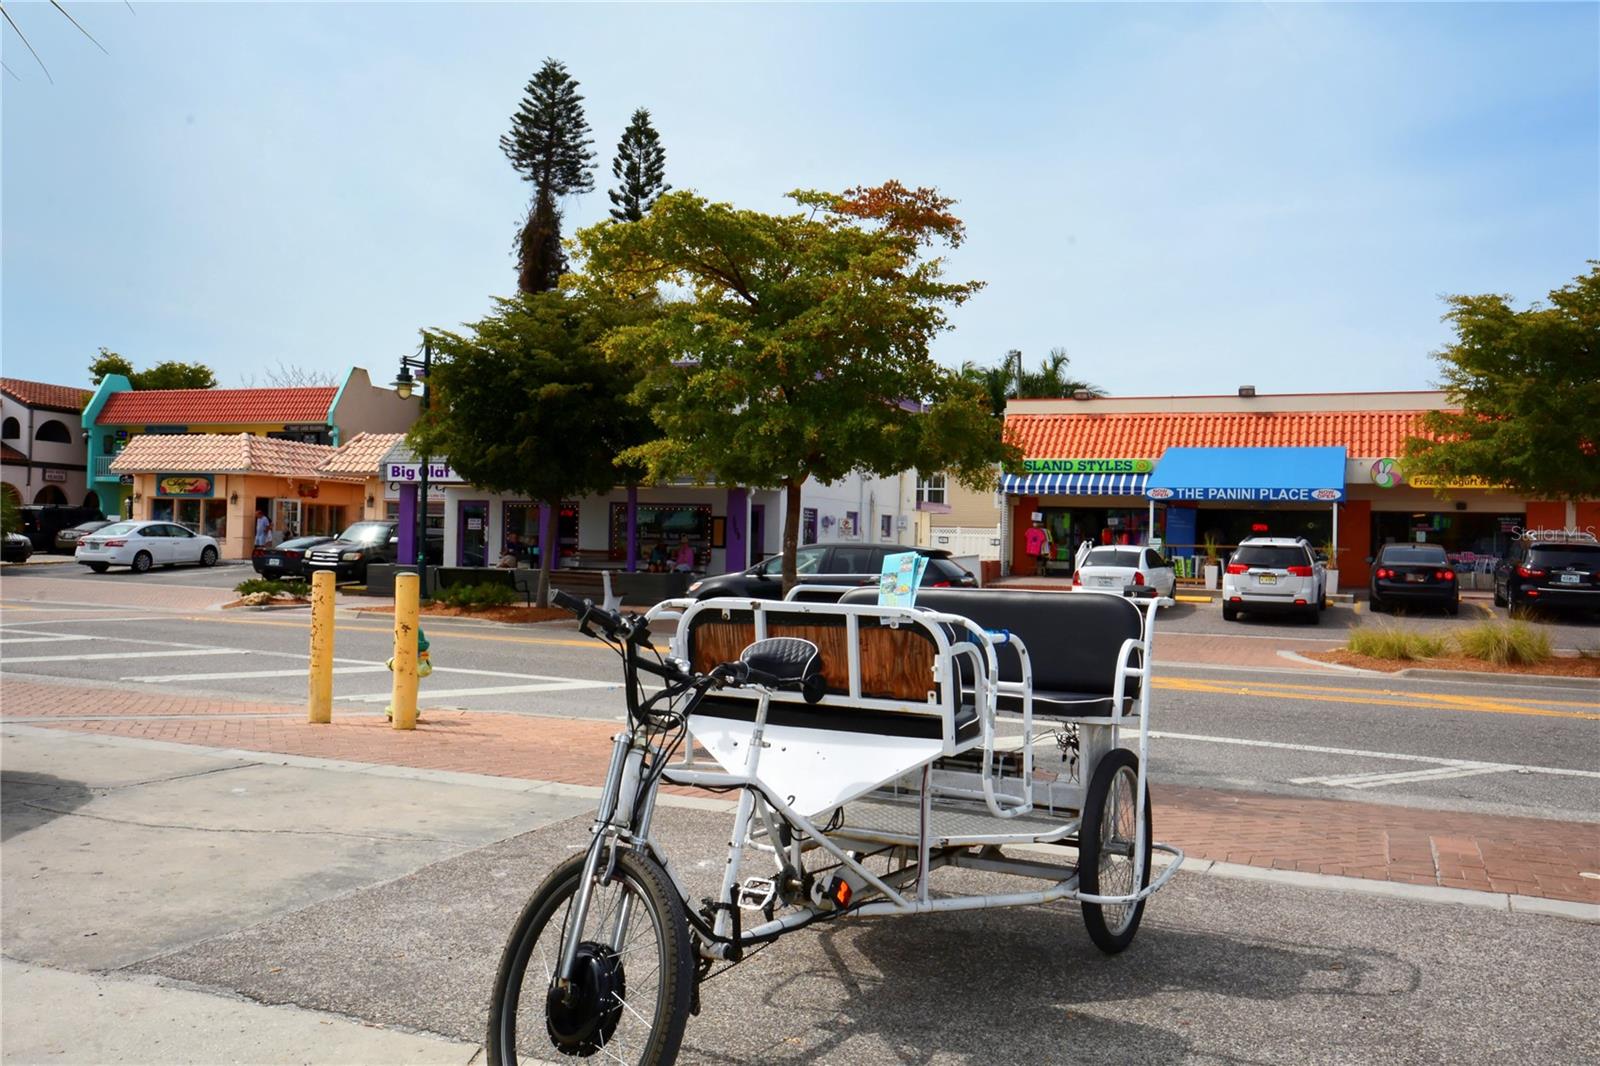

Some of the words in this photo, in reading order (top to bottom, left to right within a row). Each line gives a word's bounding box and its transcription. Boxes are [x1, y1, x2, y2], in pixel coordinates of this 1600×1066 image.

[1022, 460, 1074, 472] SLAND
[1077, 460, 1133, 472] STYLES
[391, 465, 415, 480] Big
[1176, 488, 1204, 499] THE
[1208, 488, 1255, 500] PANINI
[1259, 488, 1309, 500] PLACE
[787, 794, 796, 807] 2
